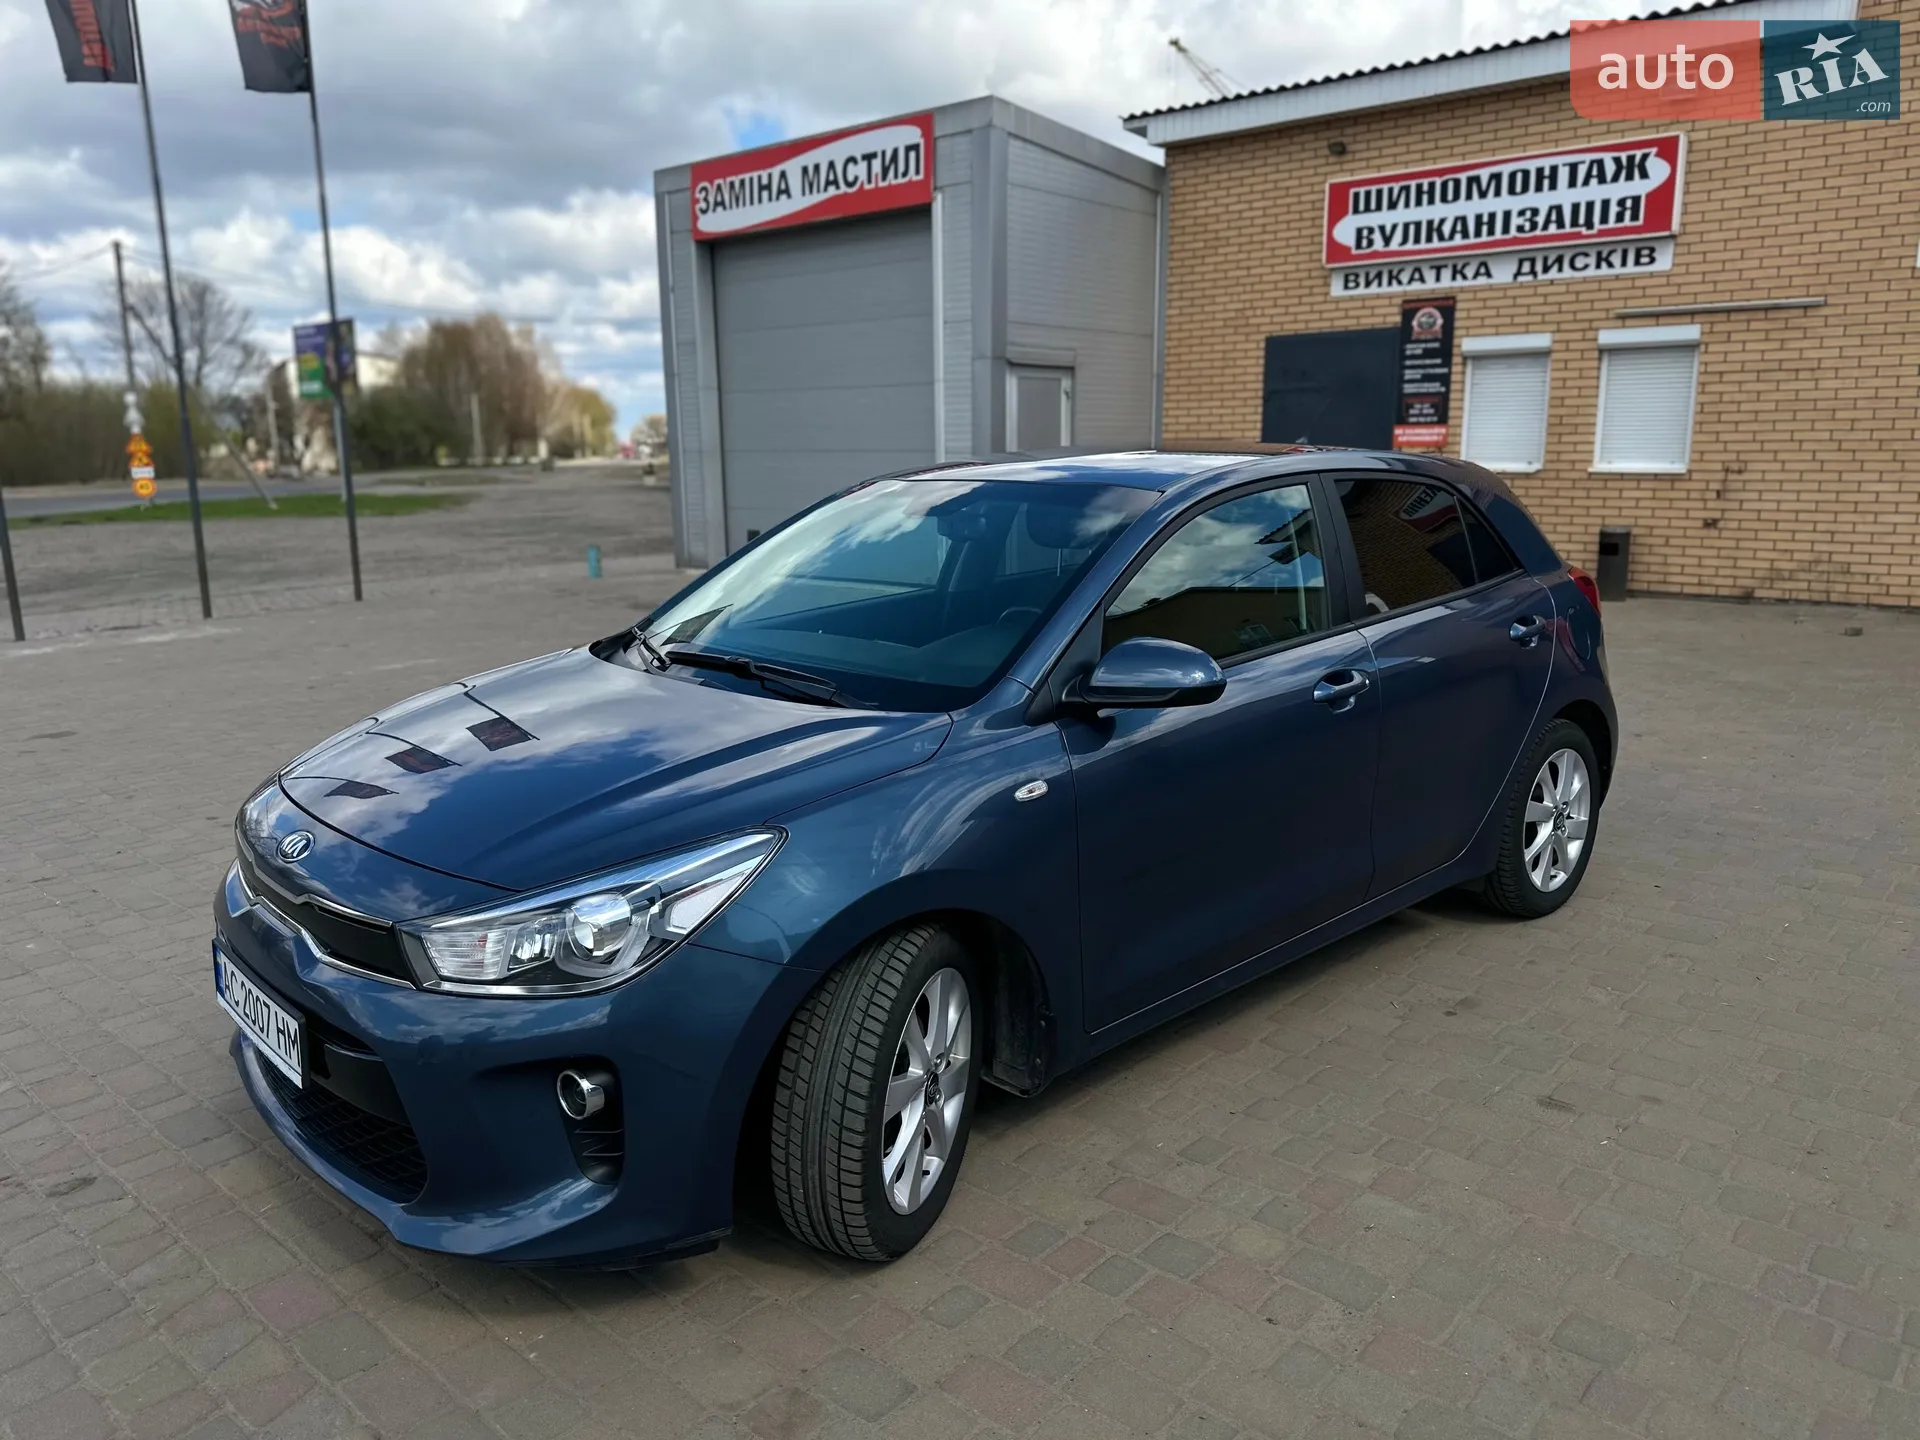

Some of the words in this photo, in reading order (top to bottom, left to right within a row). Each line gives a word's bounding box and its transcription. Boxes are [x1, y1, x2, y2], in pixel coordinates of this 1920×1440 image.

[698, 169, 792, 215] ЗАМІНА
[801, 142, 921, 197] МАСТИЛ
[1352, 151, 1653, 215] ШИНОМОНТАЖ
[1354, 194, 1643, 251] ВУЛКАНІЗАЦІЯ
[1343, 260, 1493, 291] ВИКАТКА
[1513, 246, 1657, 281] ДИСКІВ
[223, 961, 240, 1008] AC
[241, 980, 271, 1039] 2007
[275, 1010, 301, 1068] HM
